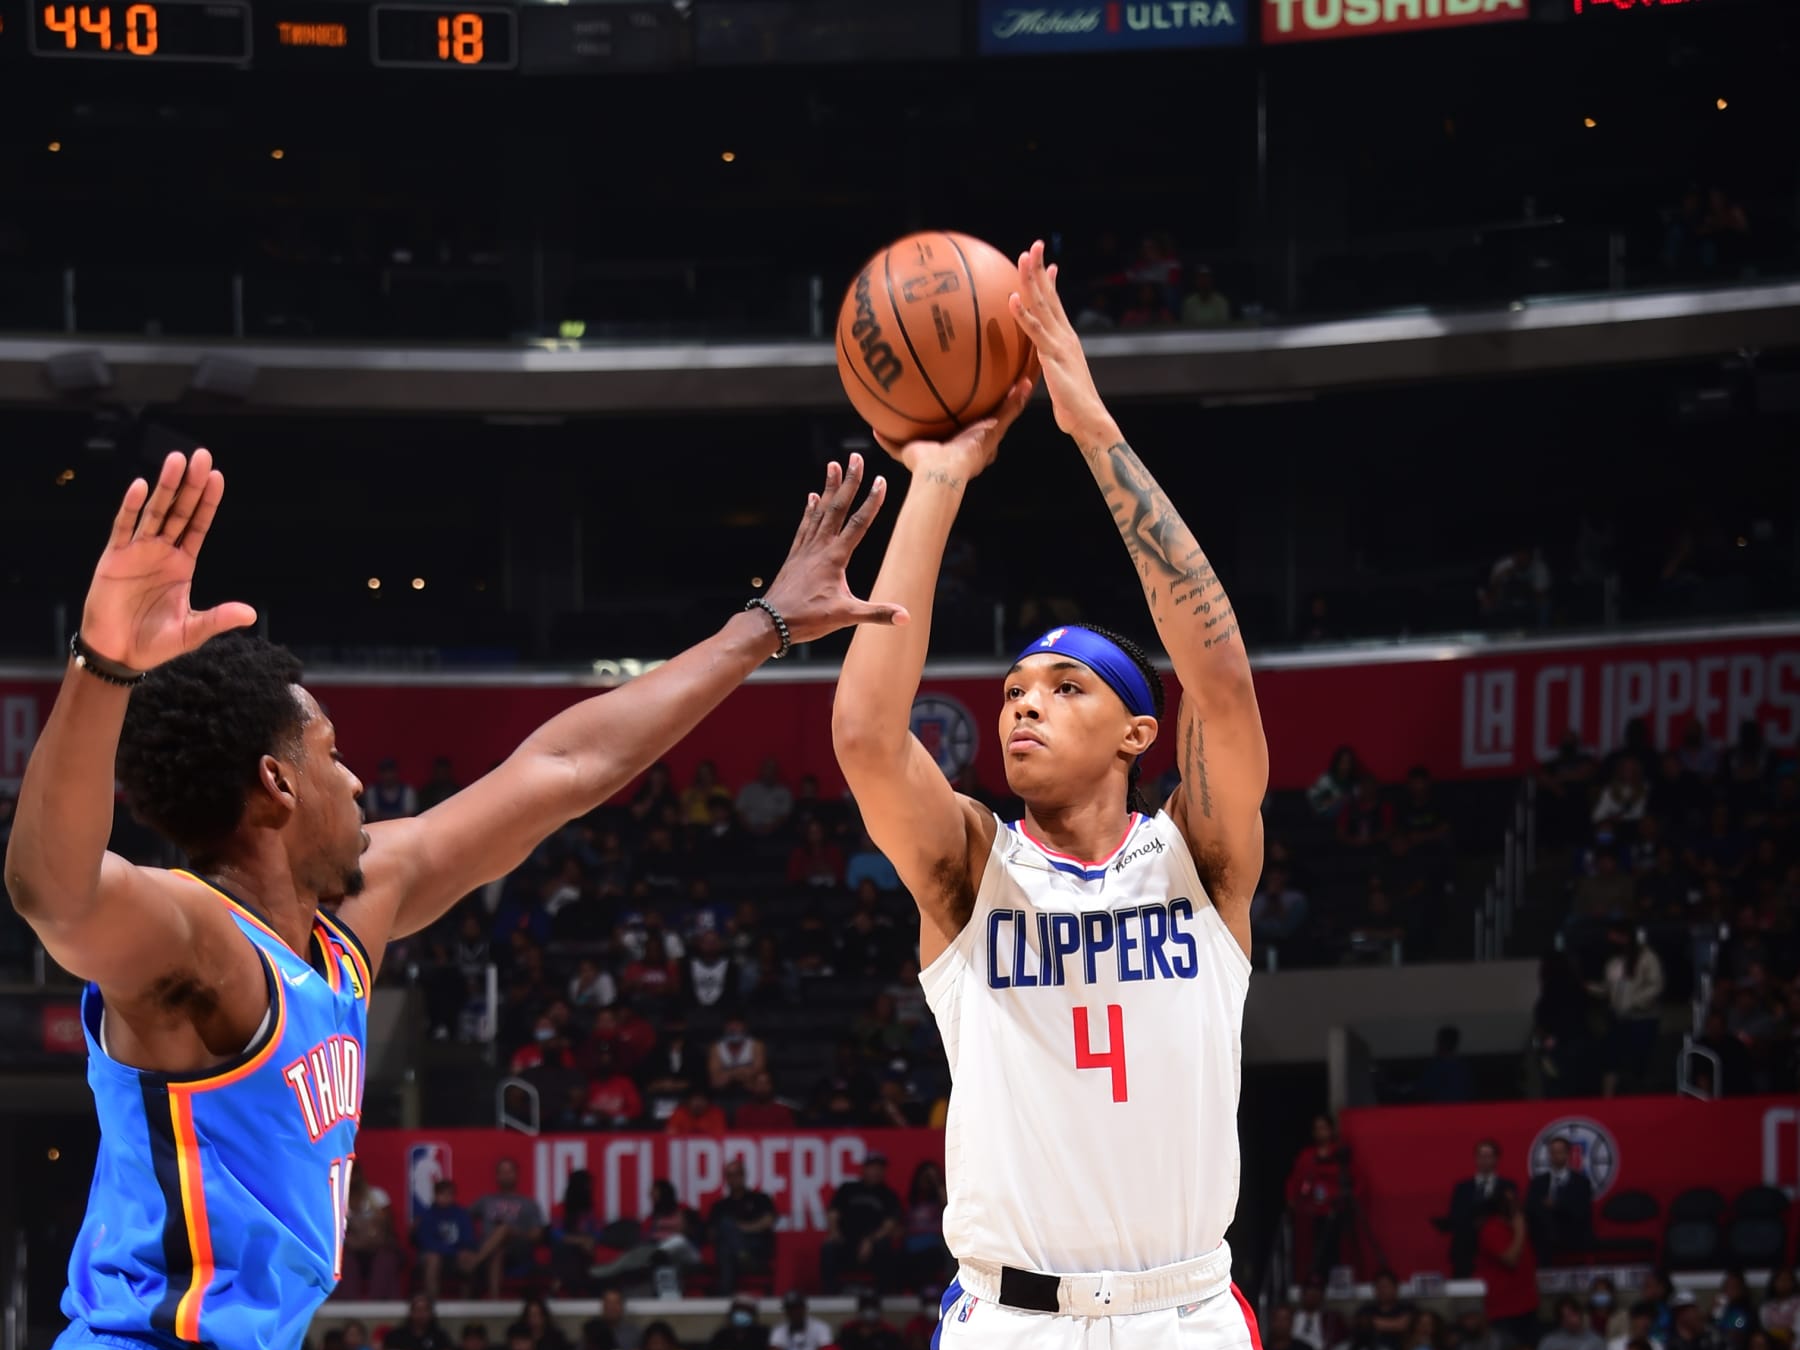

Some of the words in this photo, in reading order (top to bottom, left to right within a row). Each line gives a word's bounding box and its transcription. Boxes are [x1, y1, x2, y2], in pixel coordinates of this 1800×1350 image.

[437, 13, 483, 64] 18
[1126, 2, 1235, 30] ULTRA
[1461, 669, 1517, 769] LA
[987, 898, 1199, 990] CLIPPERS
[1072, 1004, 1128, 1103] 4
